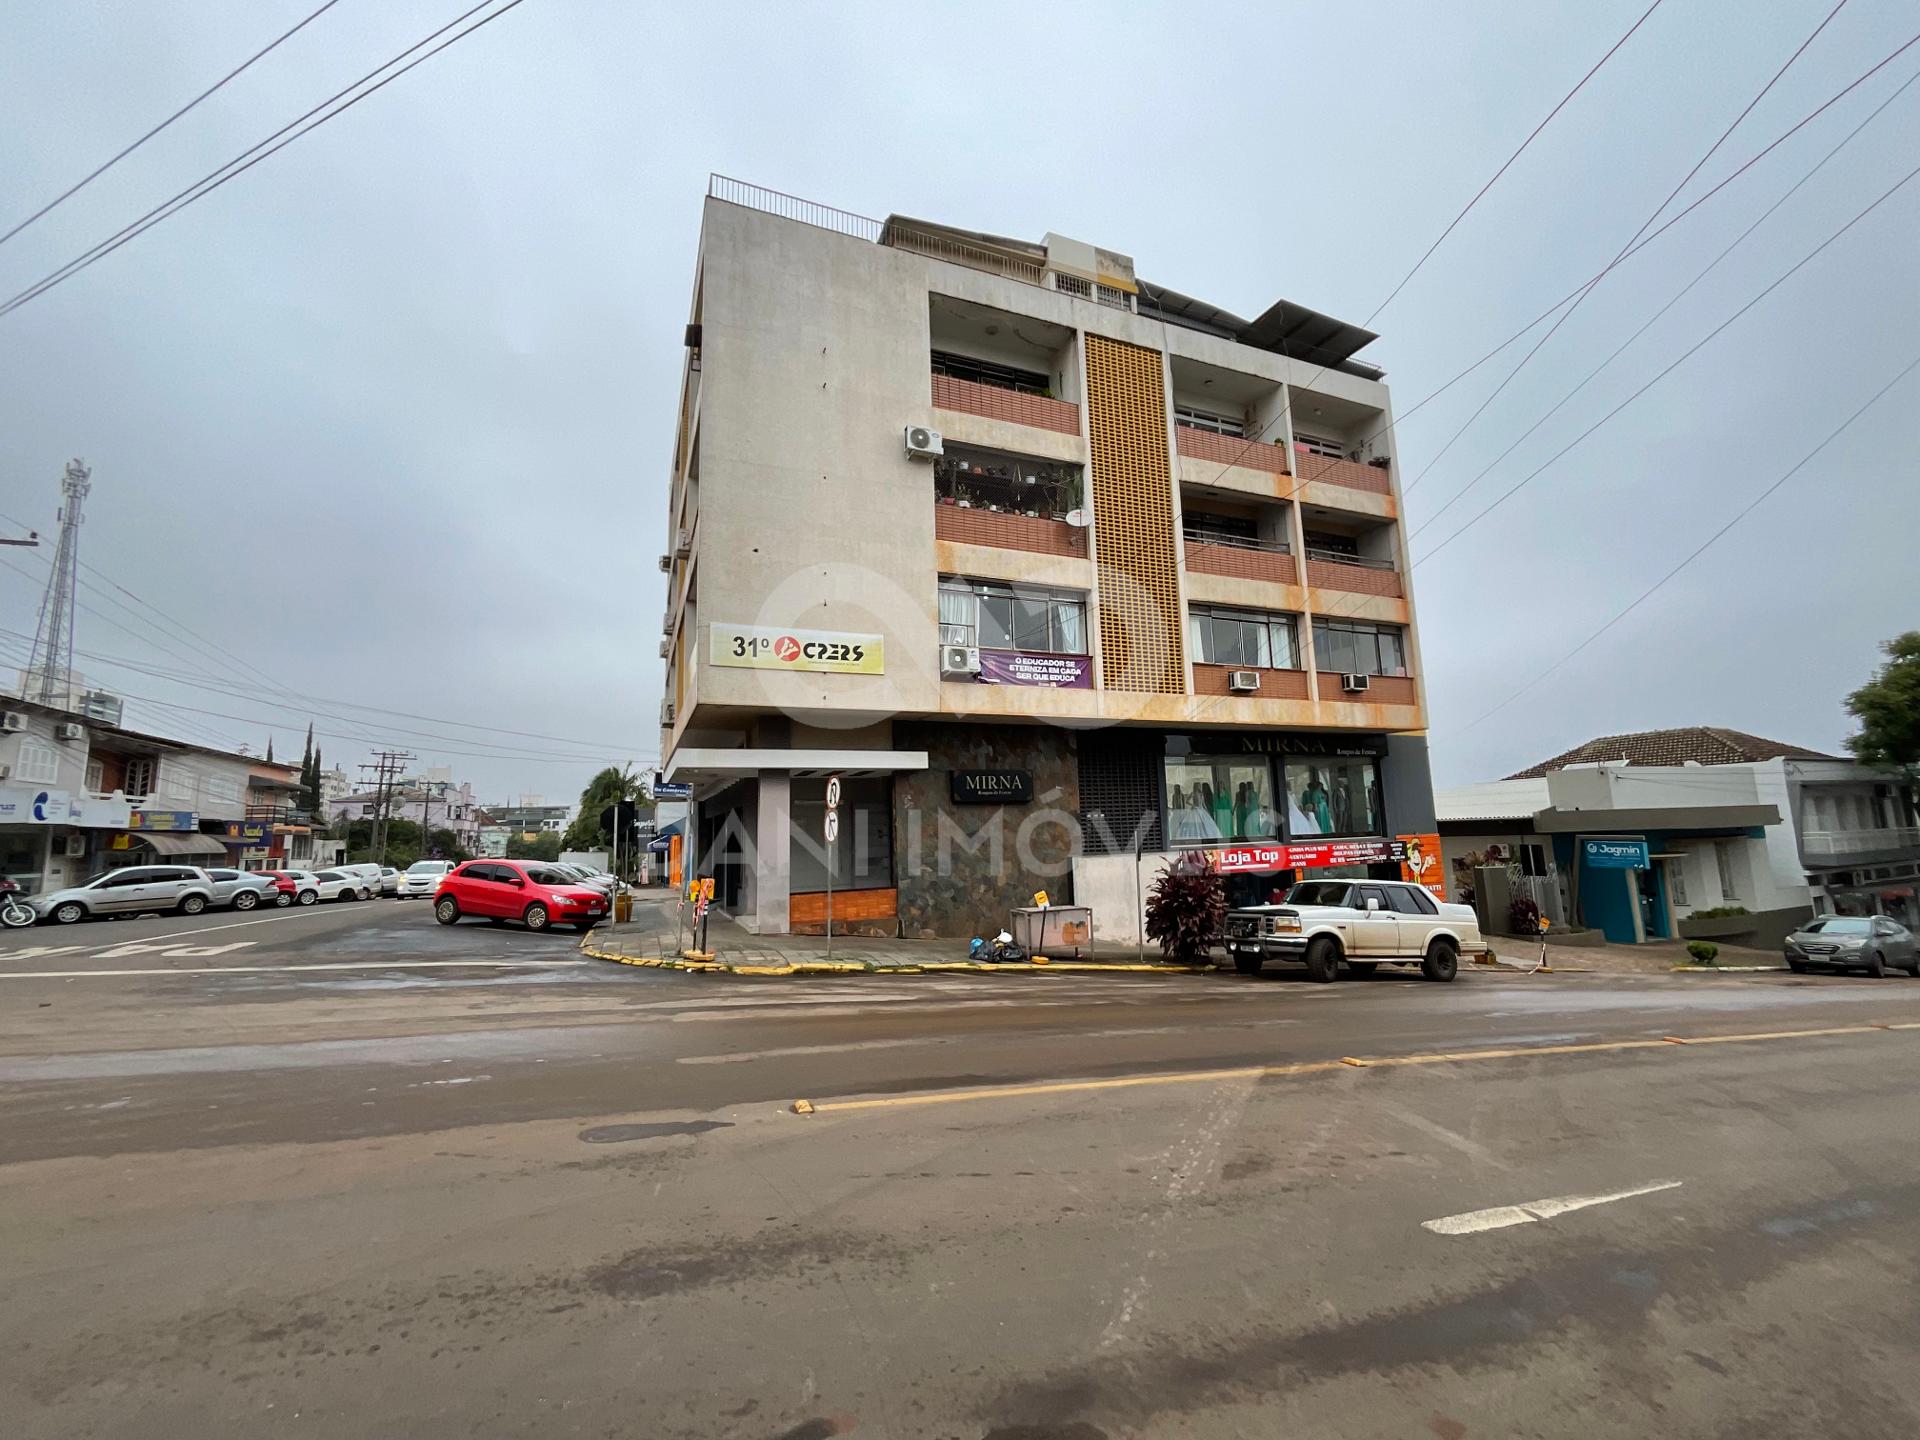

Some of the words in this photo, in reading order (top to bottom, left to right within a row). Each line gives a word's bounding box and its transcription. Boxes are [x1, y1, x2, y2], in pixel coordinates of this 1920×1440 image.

[803, 642, 864, 661] CPERS
[1009, 665, 1047, 673] ETERNIZA
[1022, 658, 1064, 667] EDUCADOR
[1016, 672, 1032, 680] SER
[1050, 674, 1075, 682] EDUCA
[1242, 737, 1325, 752] MIRNA
[966, 775, 1022, 789] MIRNA
[1600, 844, 1639, 856] Jagmin
[1221, 851, 1250, 865] Loja
[1253, 850, 1278, 863] Top
